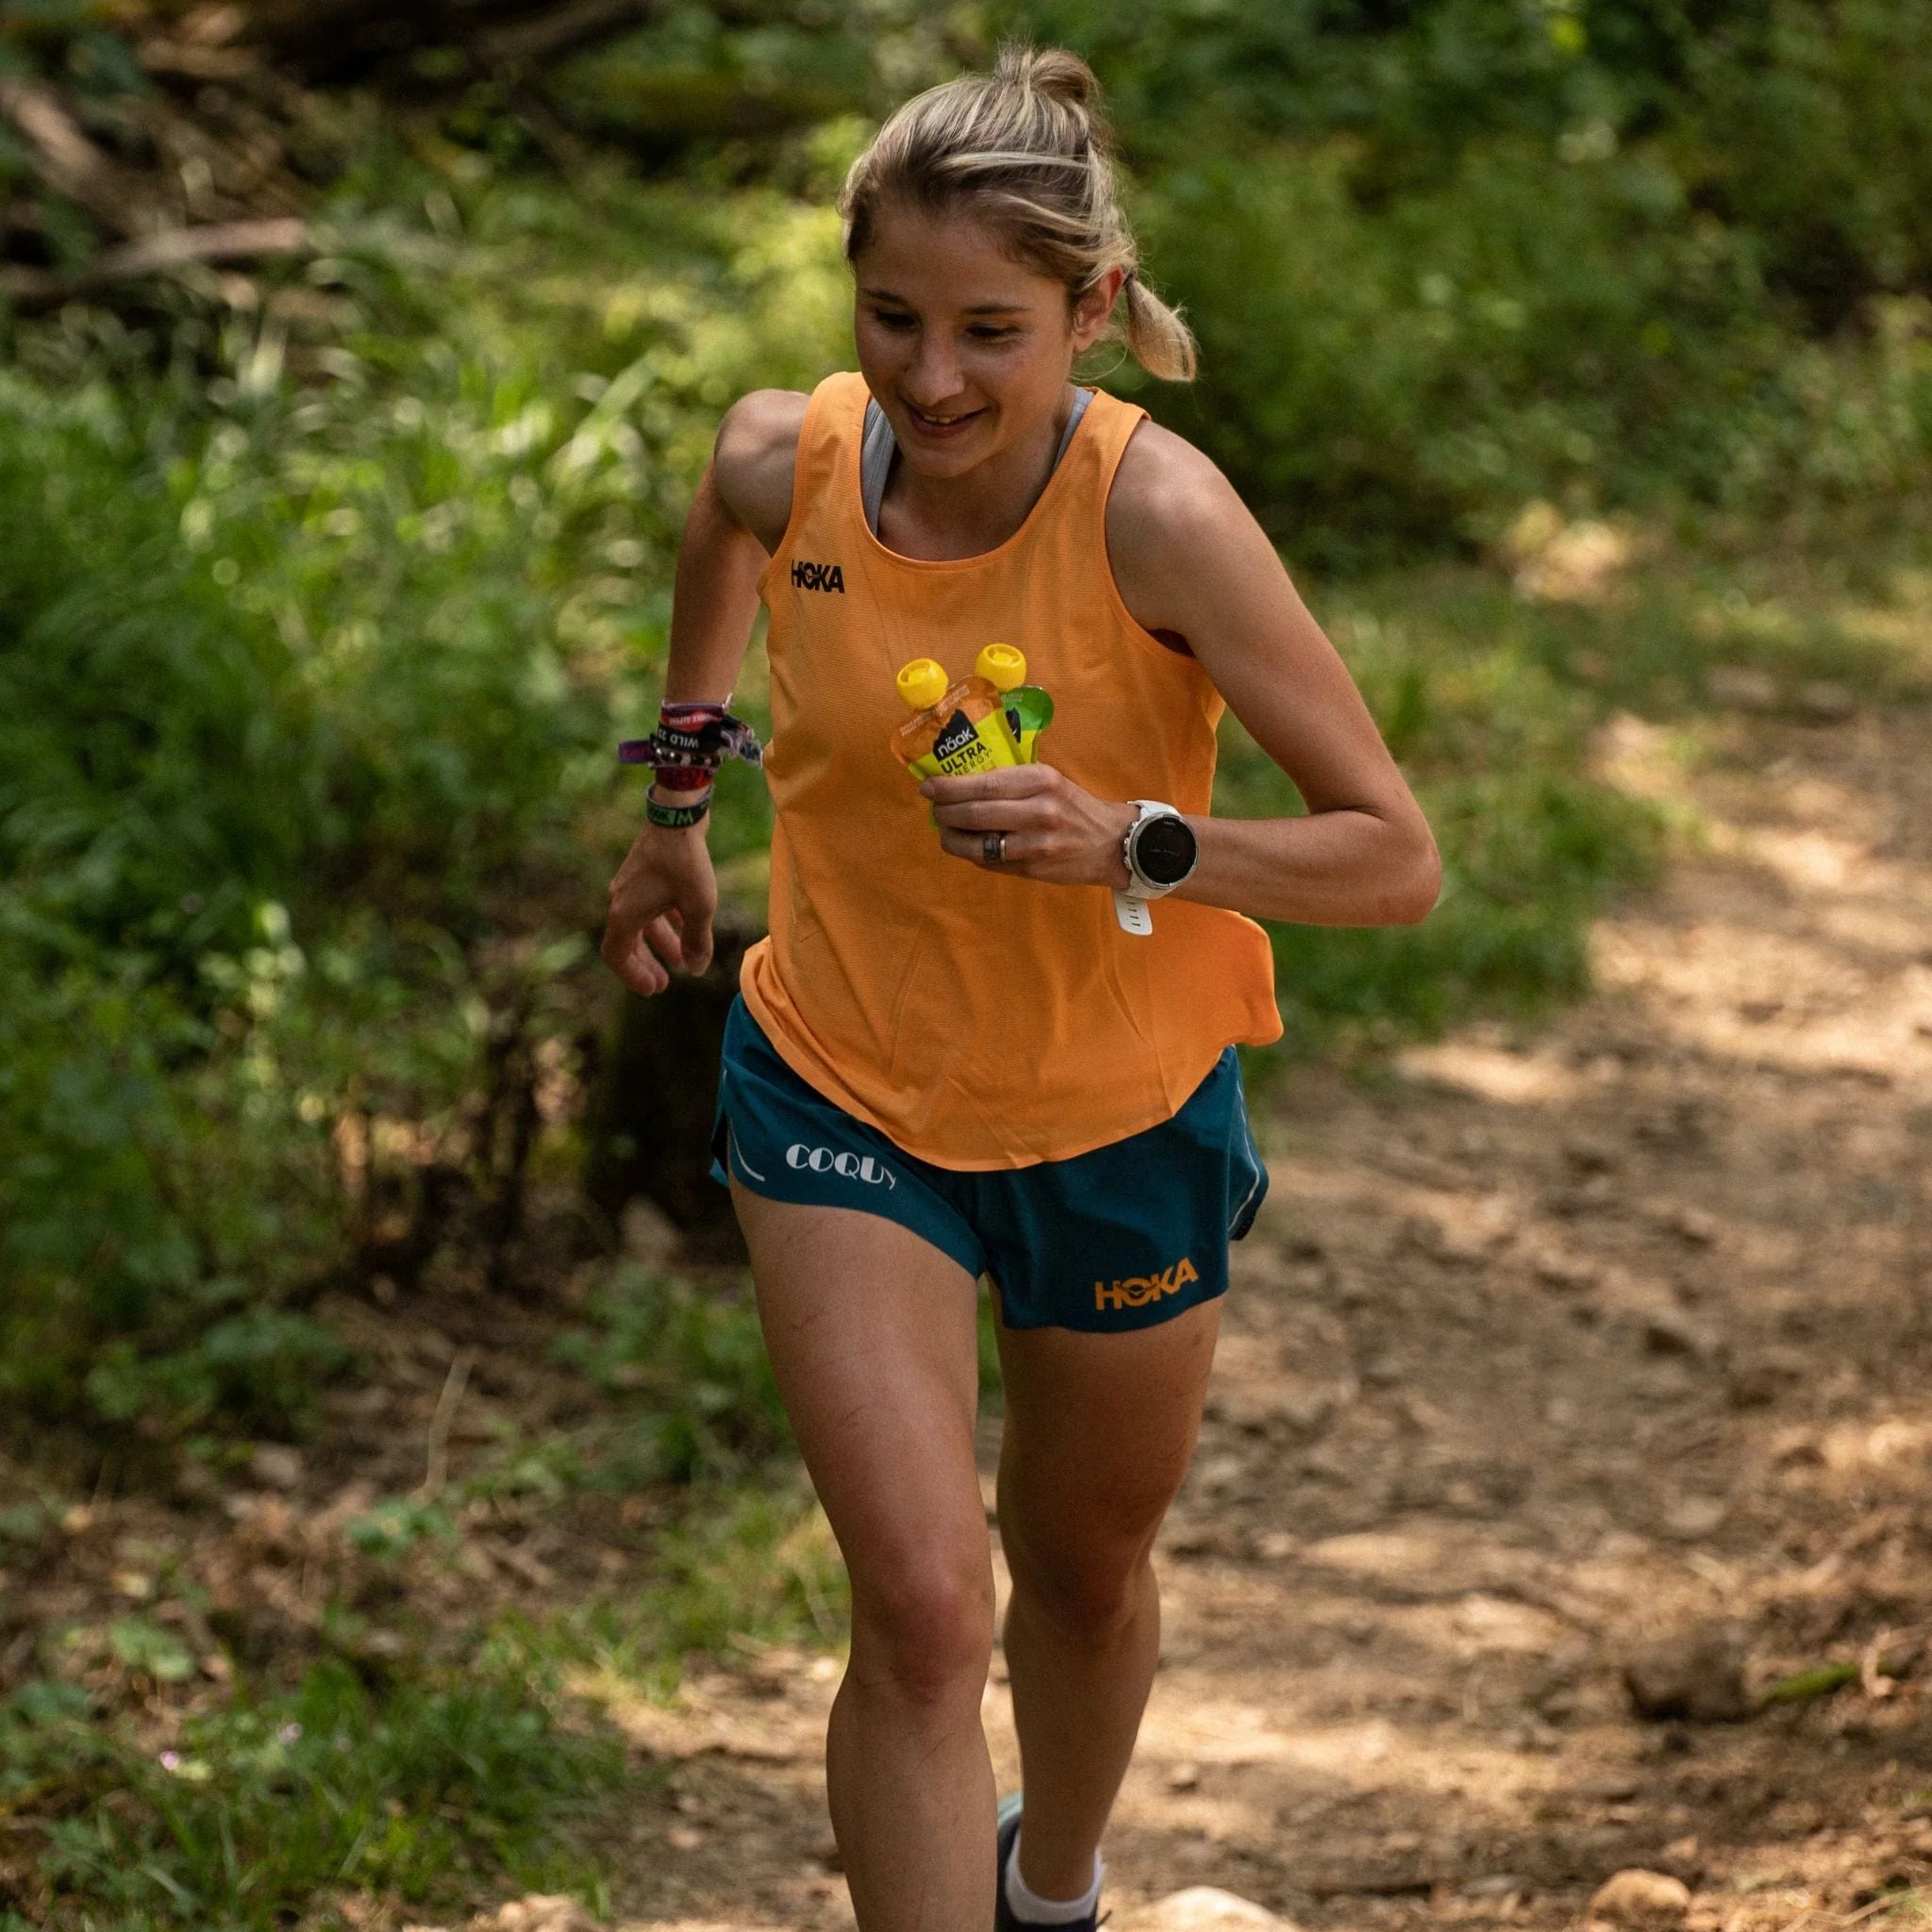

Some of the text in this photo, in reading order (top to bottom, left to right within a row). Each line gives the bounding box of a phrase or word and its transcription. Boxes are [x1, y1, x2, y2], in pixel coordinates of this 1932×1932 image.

[791, 559, 845, 593] HOKA
[670, 734, 699, 748] WILD
[938, 725, 974, 757] näak
[941, 741, 987, 774] ULTRA
[948, 749, 991, 776] NERGY
[1095, 1257, 1199, 1310] HOKA
